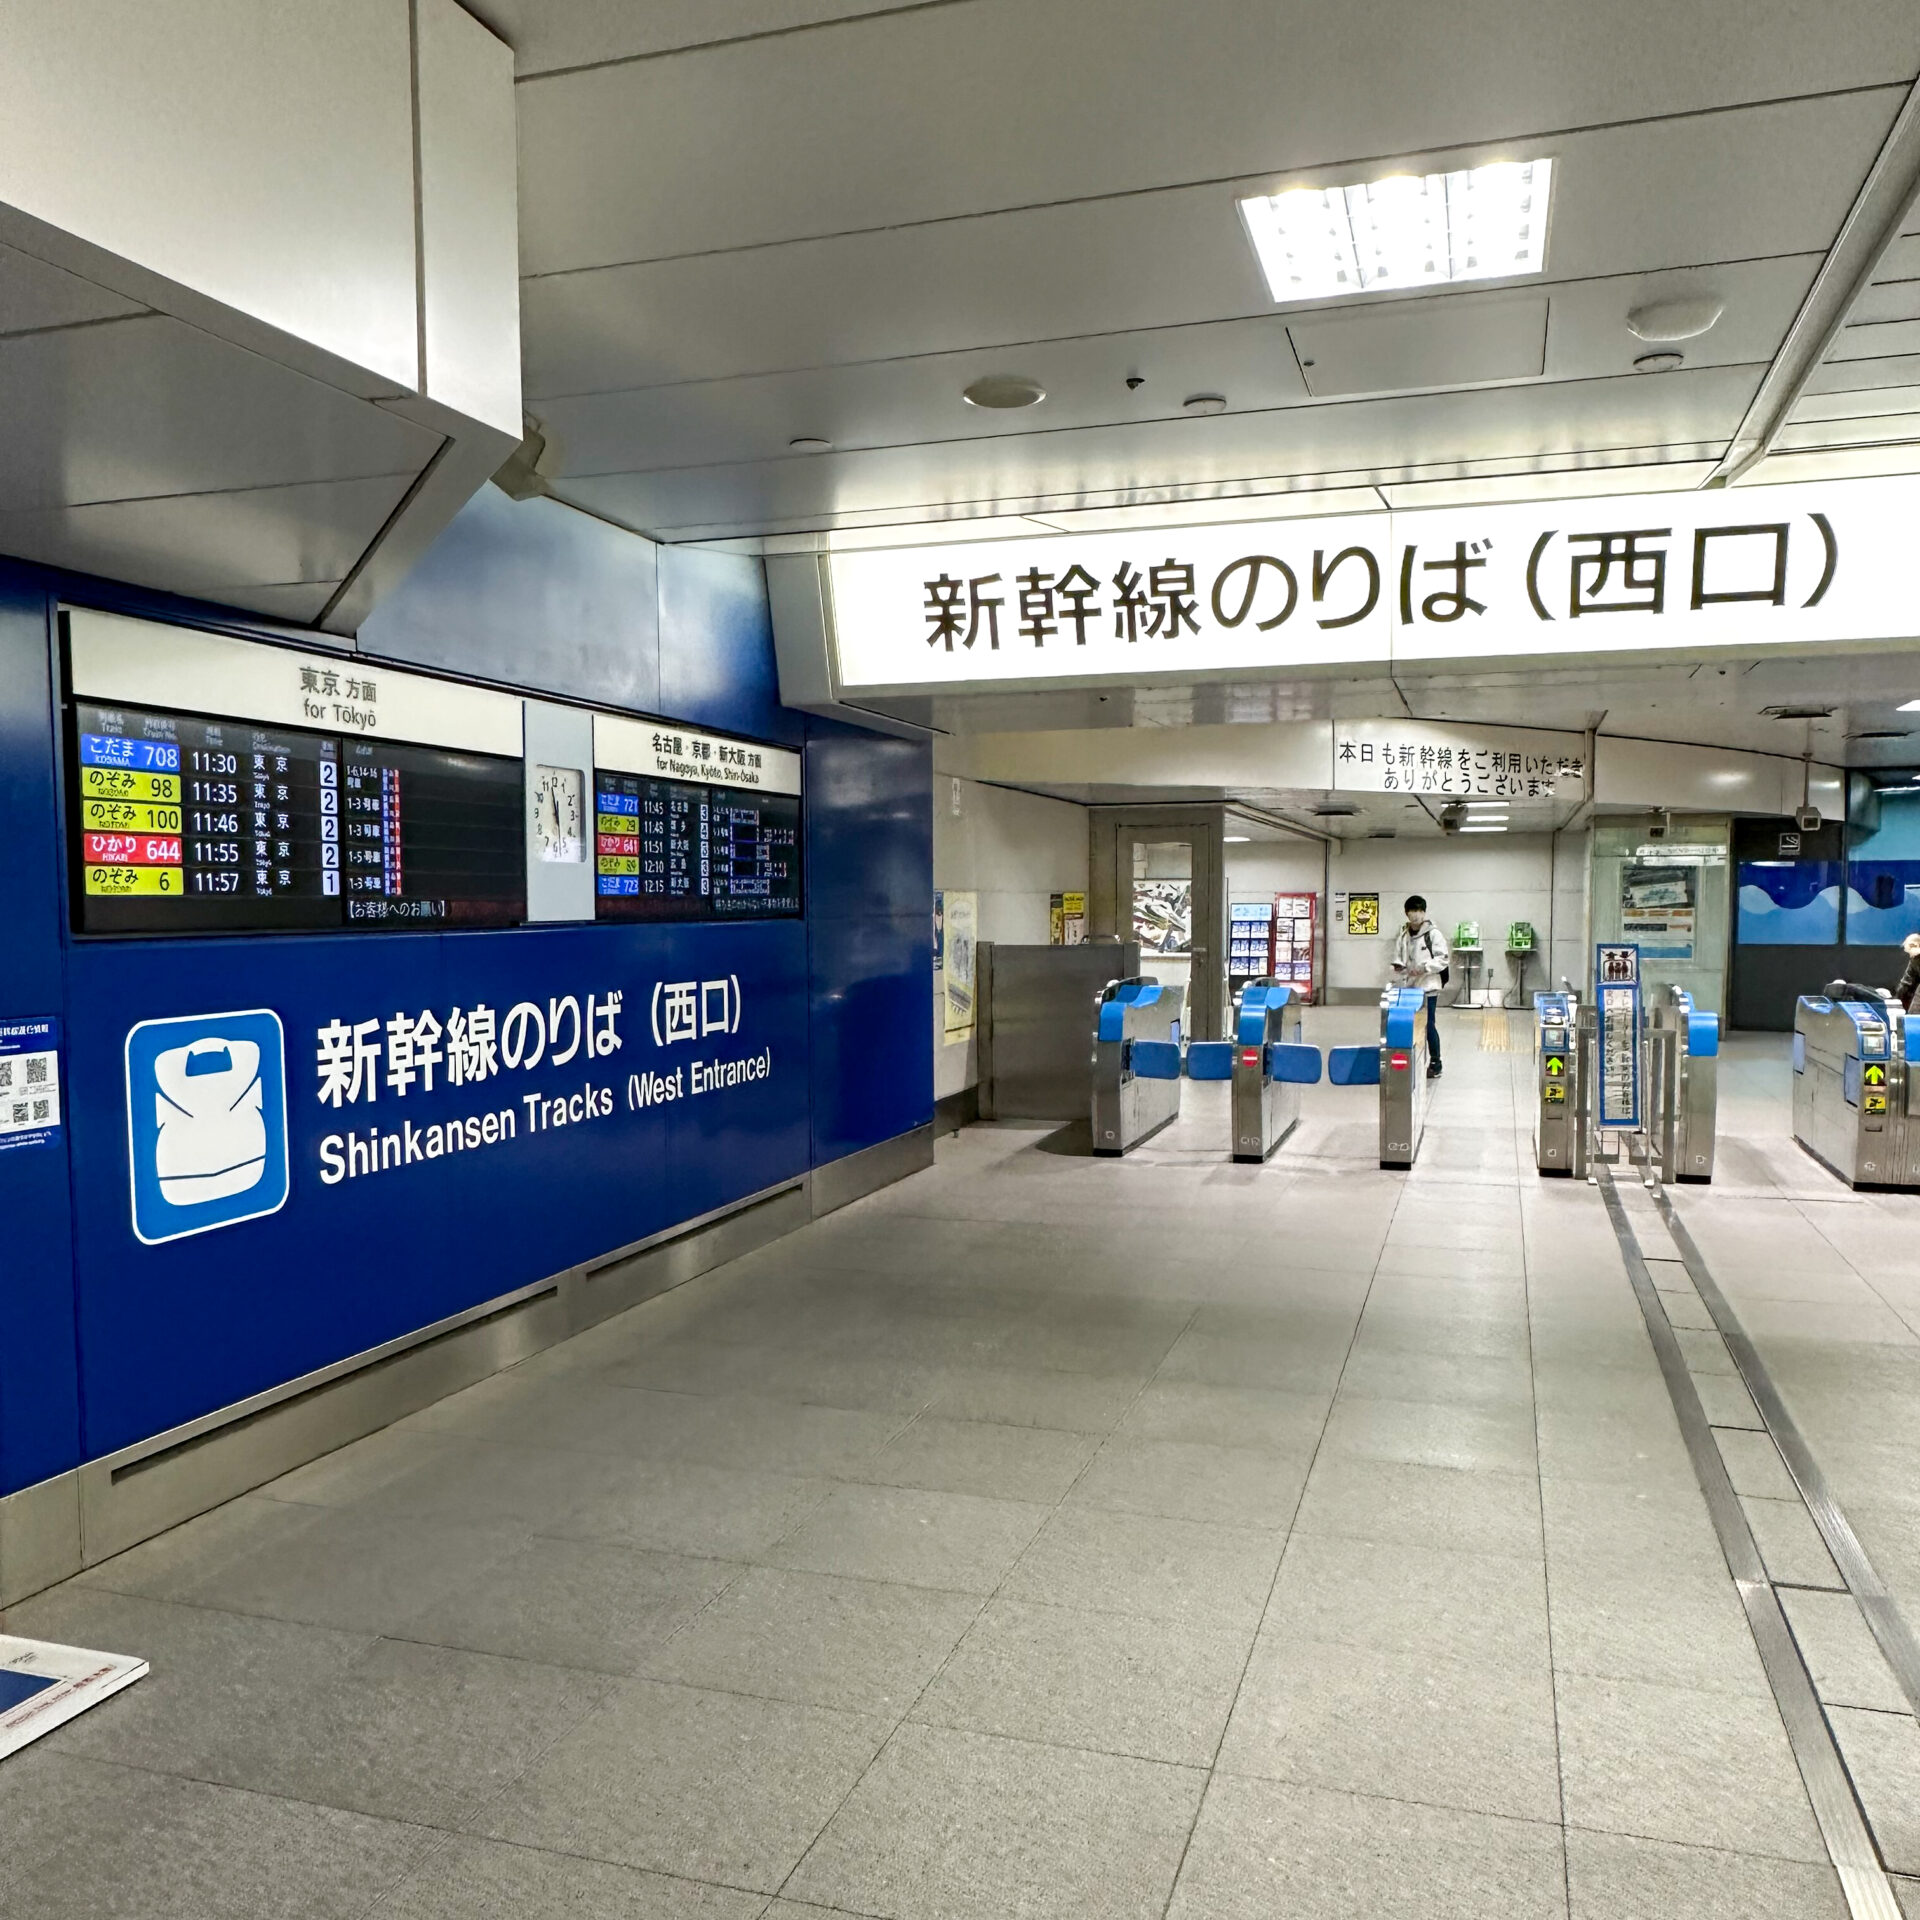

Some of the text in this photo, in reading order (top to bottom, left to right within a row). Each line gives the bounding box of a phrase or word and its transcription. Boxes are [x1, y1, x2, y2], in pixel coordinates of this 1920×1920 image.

[298, 666, 377, 702] 東京 方面
[303, 698, 377, 731] for Tōkyō
[90, 737, 134, 757] こだま
[144, 746, 178, 768] 708
[193, 751, 237, 773] 11:30
[656, 755, 667, 770] for
[89, 770, 136, 788] のぞみ
[151, 778, 173, 798] 98
[193, 782, 237, 804] 11:35
[90, 803, 136, 821] のぞみ
[624, 798, 639, 813] 721
[644, 800, 664, 815] 11:45
[147, 809, 179, 830] 100
[193, 812, 238, 832] 11:46
[92, 835, 136, 853] ひかり
[146, 840, 180, 861] 644
[194, 842, 239, 862] 11:55
[92, 868, 139, 884] のぞみ
[644, 859, 665, 873] 12:10
[159, 871, 170, 892] 6
[195, 873, 240, 892] 11:57
[644, 879, 665, 893] 12:15
[316, 989, 623, 1108] 新幹線のりば
[319, 1046, 772, 1185] Shinkansen Tracks (West Entrance)
